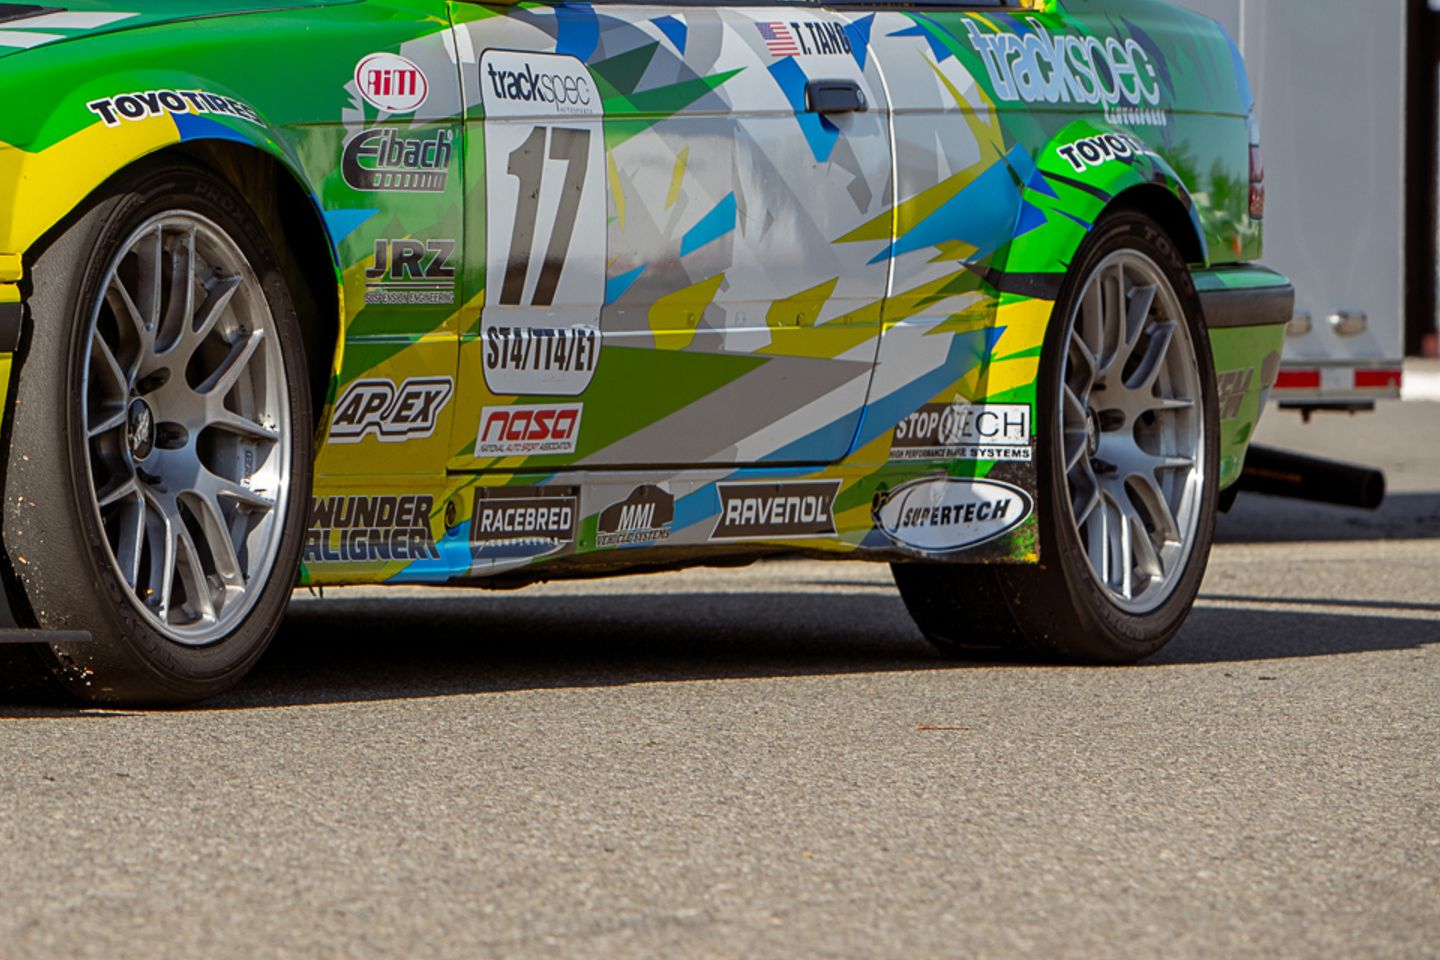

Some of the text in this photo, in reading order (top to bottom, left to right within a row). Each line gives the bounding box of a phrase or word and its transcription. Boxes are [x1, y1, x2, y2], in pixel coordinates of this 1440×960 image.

[961, 16, 1160, 107] trackspec
[488, 63, 592, 111] trackspec
[341, 128, 453, 192] Eibach
[499, 126, 591, 306] 17
[365, 238, 456, 280] JRZ
[487, 325, 596, 371] ST4/TT4/E1
[333, 389, 444, 426] APEX
[970, 448, 1030, 458] SYSTEMS
[308, 494, 435, 529] WUNDER
[480, 507, 572, 532] RACEBRED
[725, 496, 829, 525] RAVENOL
[903, 498, 1012, 528] SUPERTECH
[303, 527, 434, 562] ALIGNER
